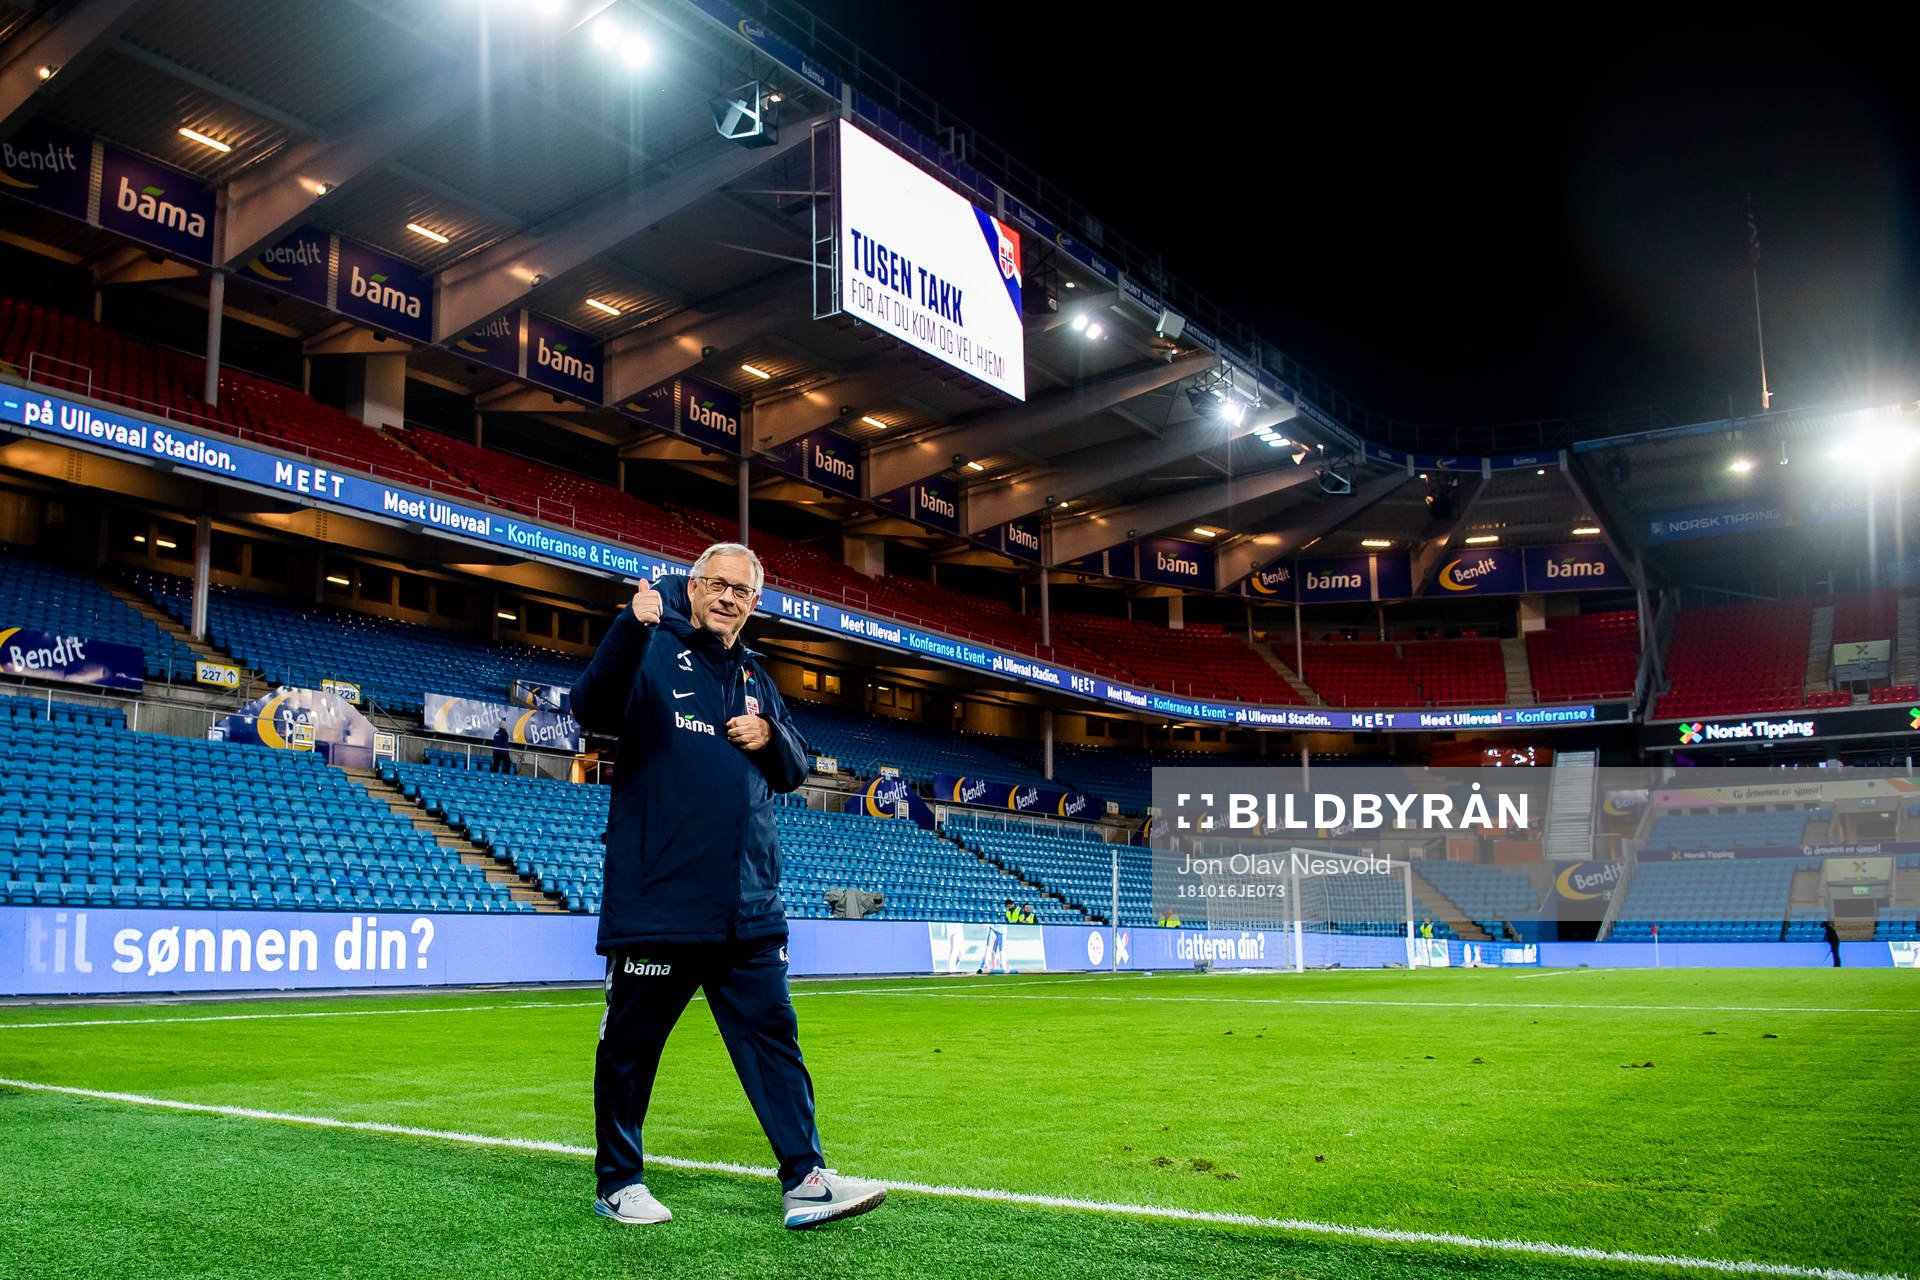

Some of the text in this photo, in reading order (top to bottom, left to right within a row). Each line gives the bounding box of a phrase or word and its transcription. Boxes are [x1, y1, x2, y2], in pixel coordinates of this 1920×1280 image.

[2, 142, 77, 173] Bendit
[851, 228, 963, 327] TUSEN TAKK
[852, 278, 1006, 382] FOR AT DU KOM OG VEL HJEM!
[24, 400, 53, 425] på
[60, 406, 147, 449] Ullevaal
[152, 430, 237, 472] Stadion.
[274, 461, 345, 498] MEET
[384, 489, 427, 520] Meet
[429, 501, 490, 536] Ullevaal
[507, 524, 587, 561] Konferanse
[589, 545, 600, 563] &
[602, 548, 639, 573] Event
[1668, 509, 1780, 532] NORSK TIPPING
[1261, 568, 1291, 585] Bendit
[1454, 557, 1497, 583] Bendit
[782, 596, 820, 622] MEET
[10, 635, 85, 672] Bendit
[840, 613, 865, 634] Meet
[866, 620, 901, 643] Ullevaal
[909, 633, 955, 657] Konferanse
[955, 645, 963, 659] &
[963, 647, 986, 665] Event
[992, 655, 1003, 671] på
[1003, 657, 1032, 678] Ullevaal
[1032, 665, 1060, 684] Stadion.
[201, 669, 221, 681] 227
[1071, 675, 1095, 693] MEET
[338, 689, 356, 701] 228
[1107, 685, 1122, 701] Meet
[1123, 688, 1147, 706] Ullevaal
[1154, 697, 1193, 716] Konferanse
[1193, 704, 1201, 717] &
[1201, 705, 1227, 719] Event
[1235, 710, 1247, 723] på
[1248, 710, 1287, 724] Ullevaal
[1288, 712, 1331, 726] Stadion.
[454, 701, 501, 734] Bendit
[530, 713, 576, 744] Bendit
[1352, 713, 1395, 728] MEET
[1420, 714, 1452, 727] Meet
[1453, 711, 1502, 726] Ullevaal
[1515, 709, 1588, 724] Konferanse
[1705, 719, 1815, 739] Norsk Tipping
[878, 780, 908, 808] Bendit
[962, 779, 987, 803] Bendit
[1016, 787, 1039, 810] Bendit
[1733, 789, 1743, 799] Gi
[1065, 795, 1087, 817] Bendit
[1684, 850, 1735, 861] Norsk Tipping
[1803, 845, 1813, 856] Gi
[1575, 862, 1624, 890] Bendit
[28, 912, 435, 976] til sønnen din?
[1177, 931, 1236, 960] datteren
[1237, 931, 1265, 960] din?
